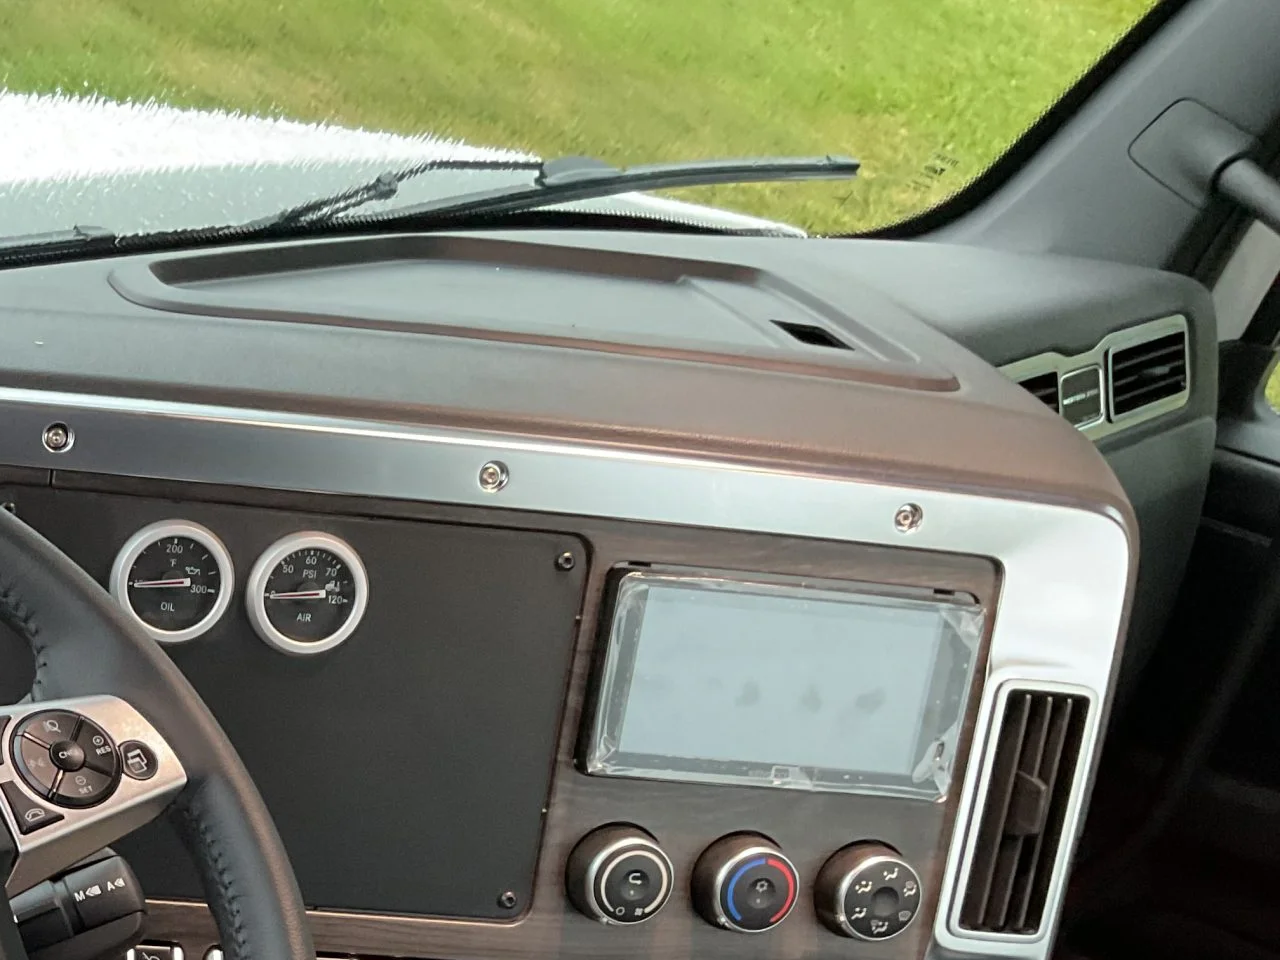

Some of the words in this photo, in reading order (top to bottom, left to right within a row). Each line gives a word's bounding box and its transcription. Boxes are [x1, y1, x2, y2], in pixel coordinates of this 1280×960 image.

[166, 544, 183, 554] 200
[305, 556, 317, 565] 60
[283, 565, 294, 575] 50
[302, 569, 317, 579] PSI
[325, 567, 338, 577] 70
[190, 585, 207, 594] 300
[328, 596, 343, 605] 120
[160, 602, 175, 612] OIL
[296, 612, 312, 622] AIR
[95, 745, 111, 755] RES
[79, 785, 93, 794] SET
[107, 880, 116, 892] A
[74, 891, 86, 902] M
